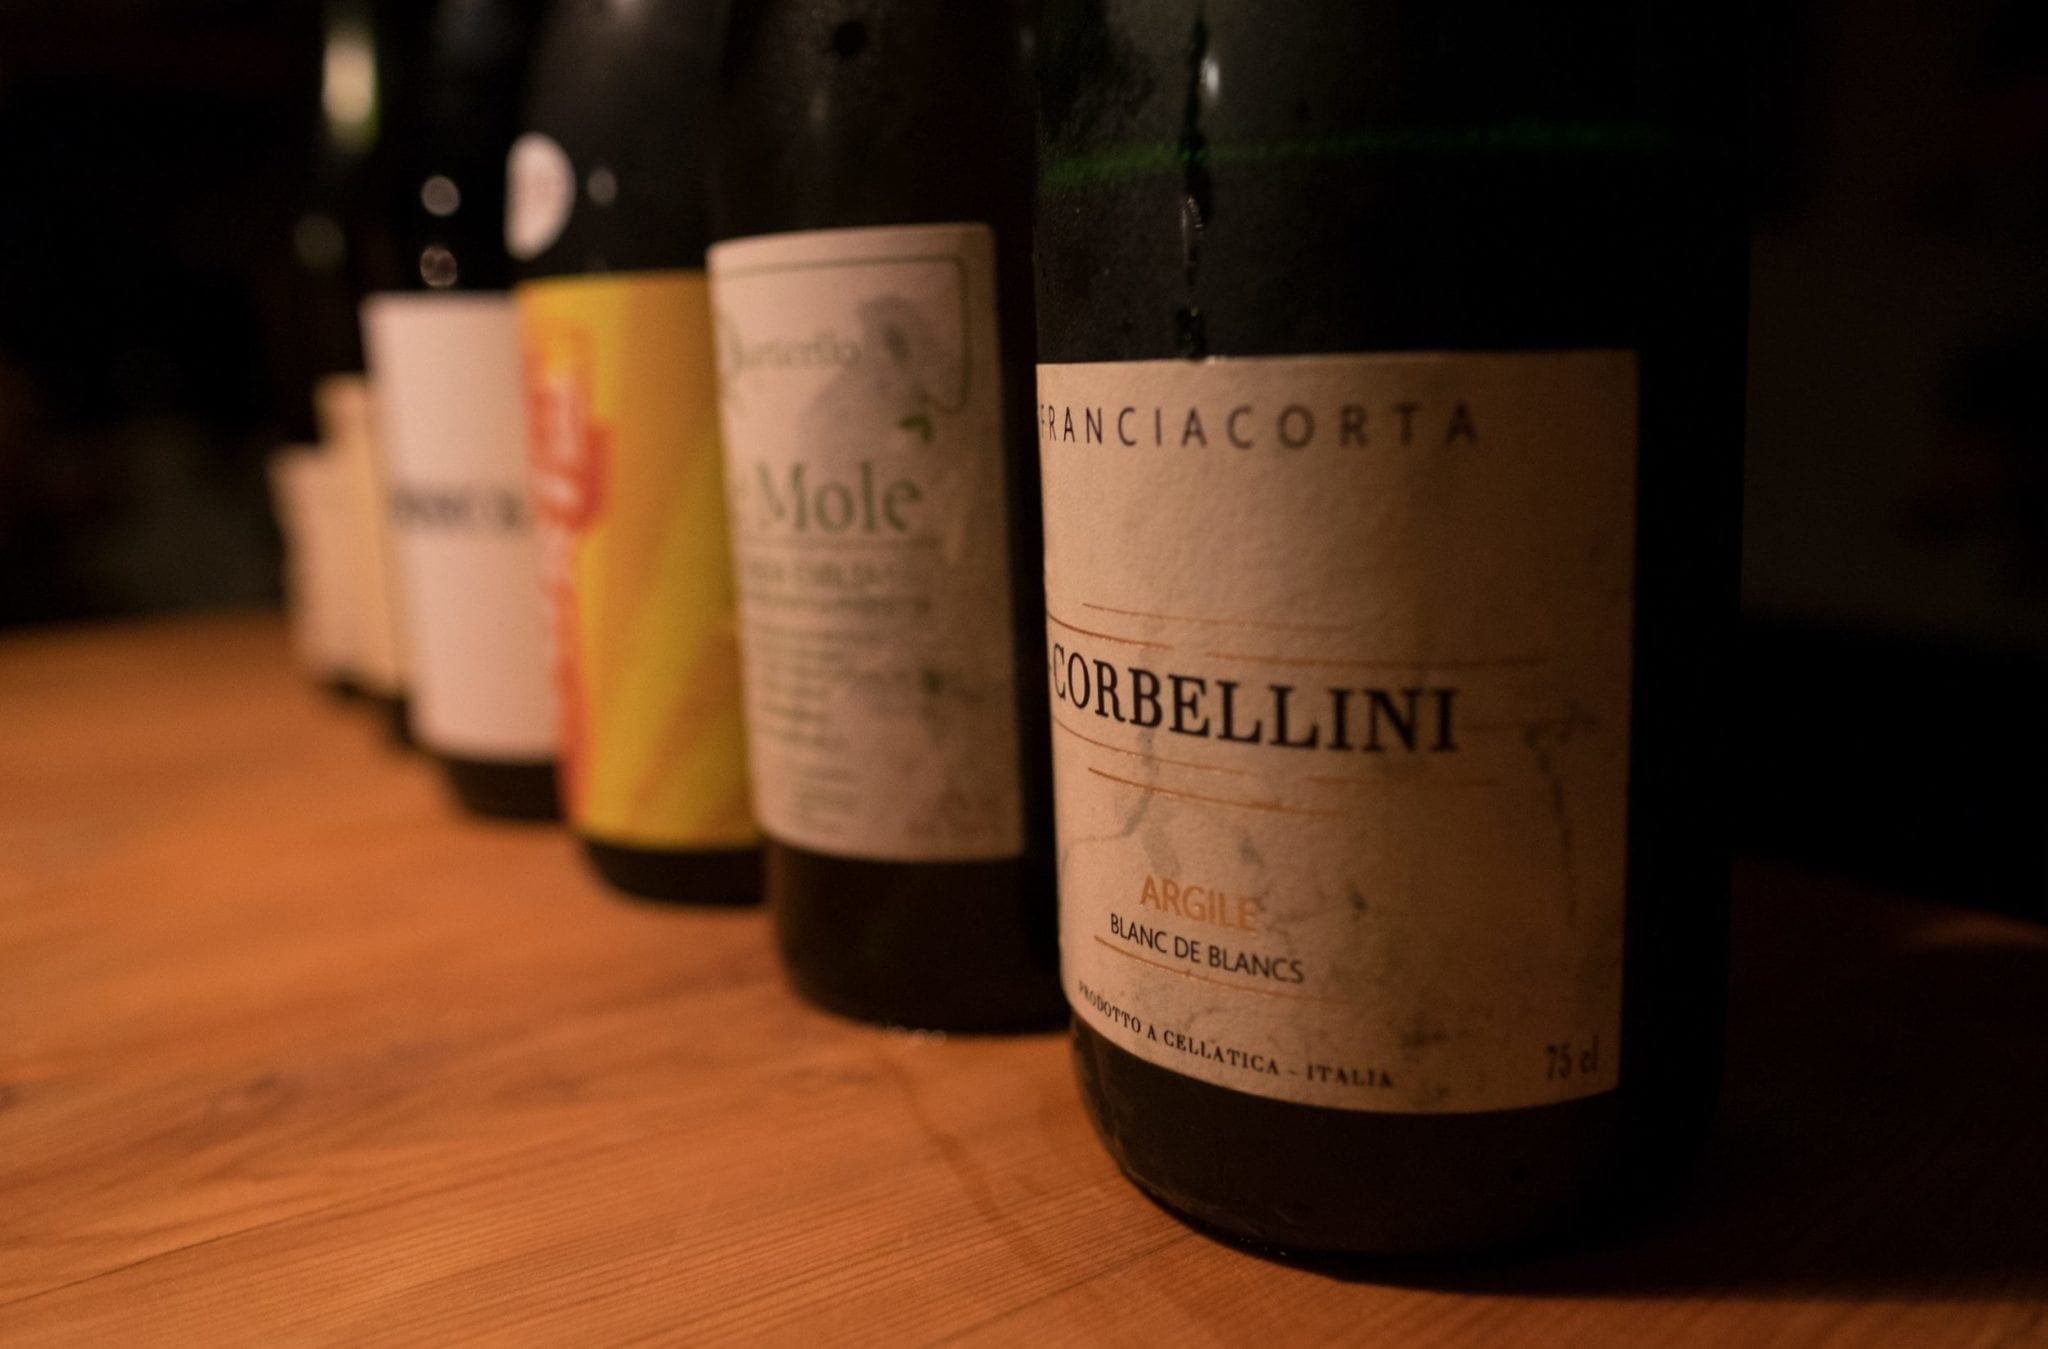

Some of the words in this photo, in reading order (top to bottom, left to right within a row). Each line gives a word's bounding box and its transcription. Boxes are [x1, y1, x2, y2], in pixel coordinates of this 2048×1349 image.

[1040, 403, 1479, 449] FRANCIACORTA
[757, 458, 923, 533] Mole
[1053, 643, 1459, 753] CORBELLINI
[1140, 873, 1258, 932] ARGILE
[1110, 912, 1168, 954] BLANC
[1174, 936, 1201, 963] DE
[1208, 944, 1305, 985] BLANCS
[1078, 979, 1142, 1034] PRODOTTO
[1147, 1024, 1157, 1042] A
[1163, 1029, 1280, 1076] CELLATICA
[1305, 1064, 1395, 1089] ITALIA
[1545, 1043, 1572, 1081] 75
[1578, 1034, 1599, 1074] cl
